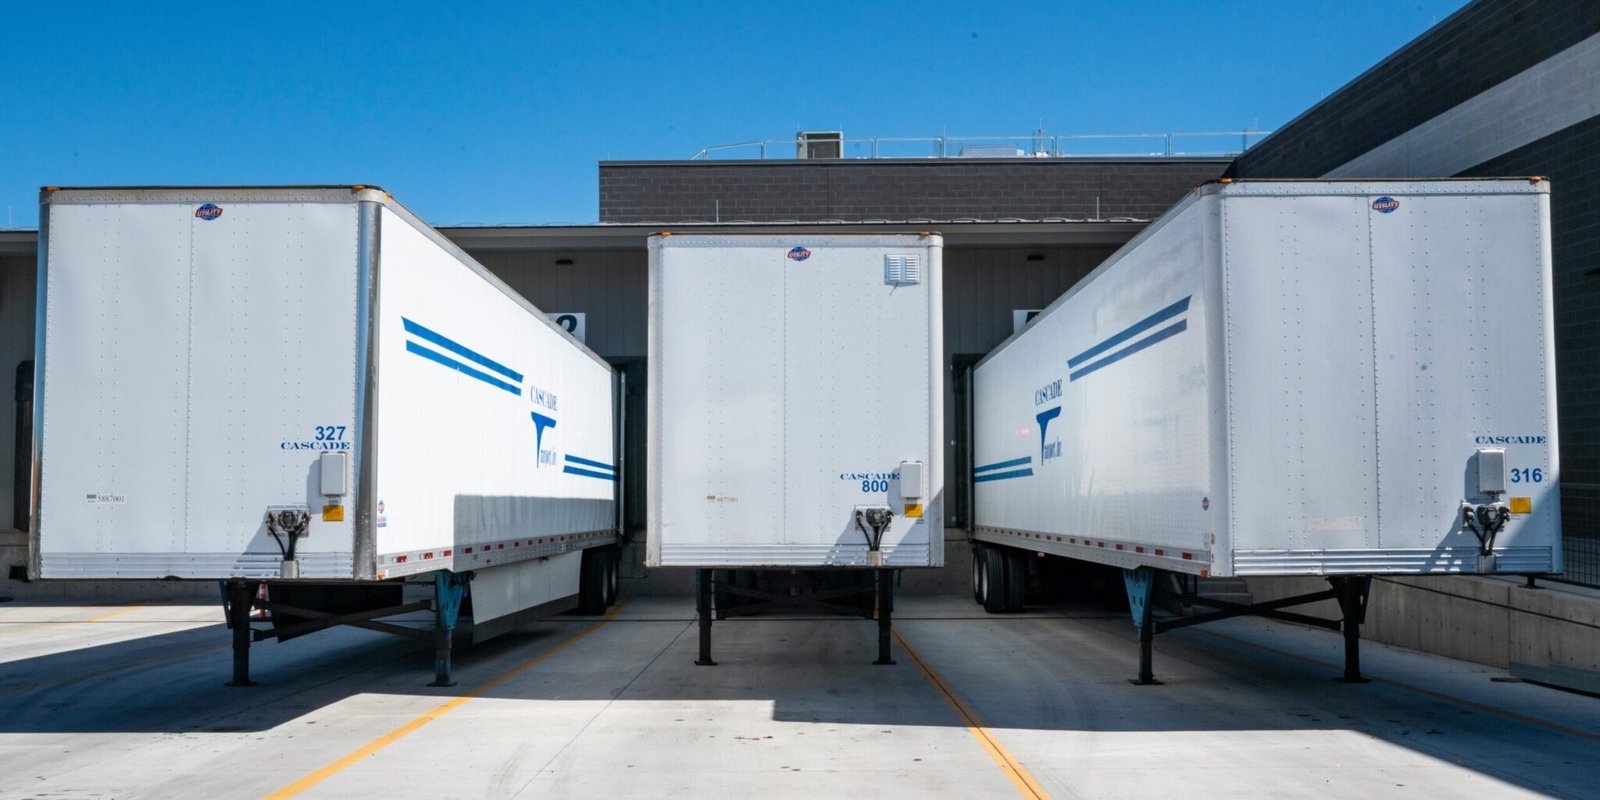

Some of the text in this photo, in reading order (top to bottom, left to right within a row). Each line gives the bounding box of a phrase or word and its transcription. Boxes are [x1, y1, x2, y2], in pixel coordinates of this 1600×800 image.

[1373, 199, 1400, 211] UTILITY
[196, 207, 222, 218] UTILITY
[787, 250, 811, 260] UTILITY
[530, 385, 557, 411] CASCADE
[1035, 379, 1062, 406] CASCADE
[315, 426, 346, 441] 327
[280, 441, 350, 450] CASCADE
[1475, 435, 1545, 445] CASCADE
[840, 472, 900, 480] CASCADE
[1511, 468, 1542, 483] 316
[862, 480, 888, 493] 800
